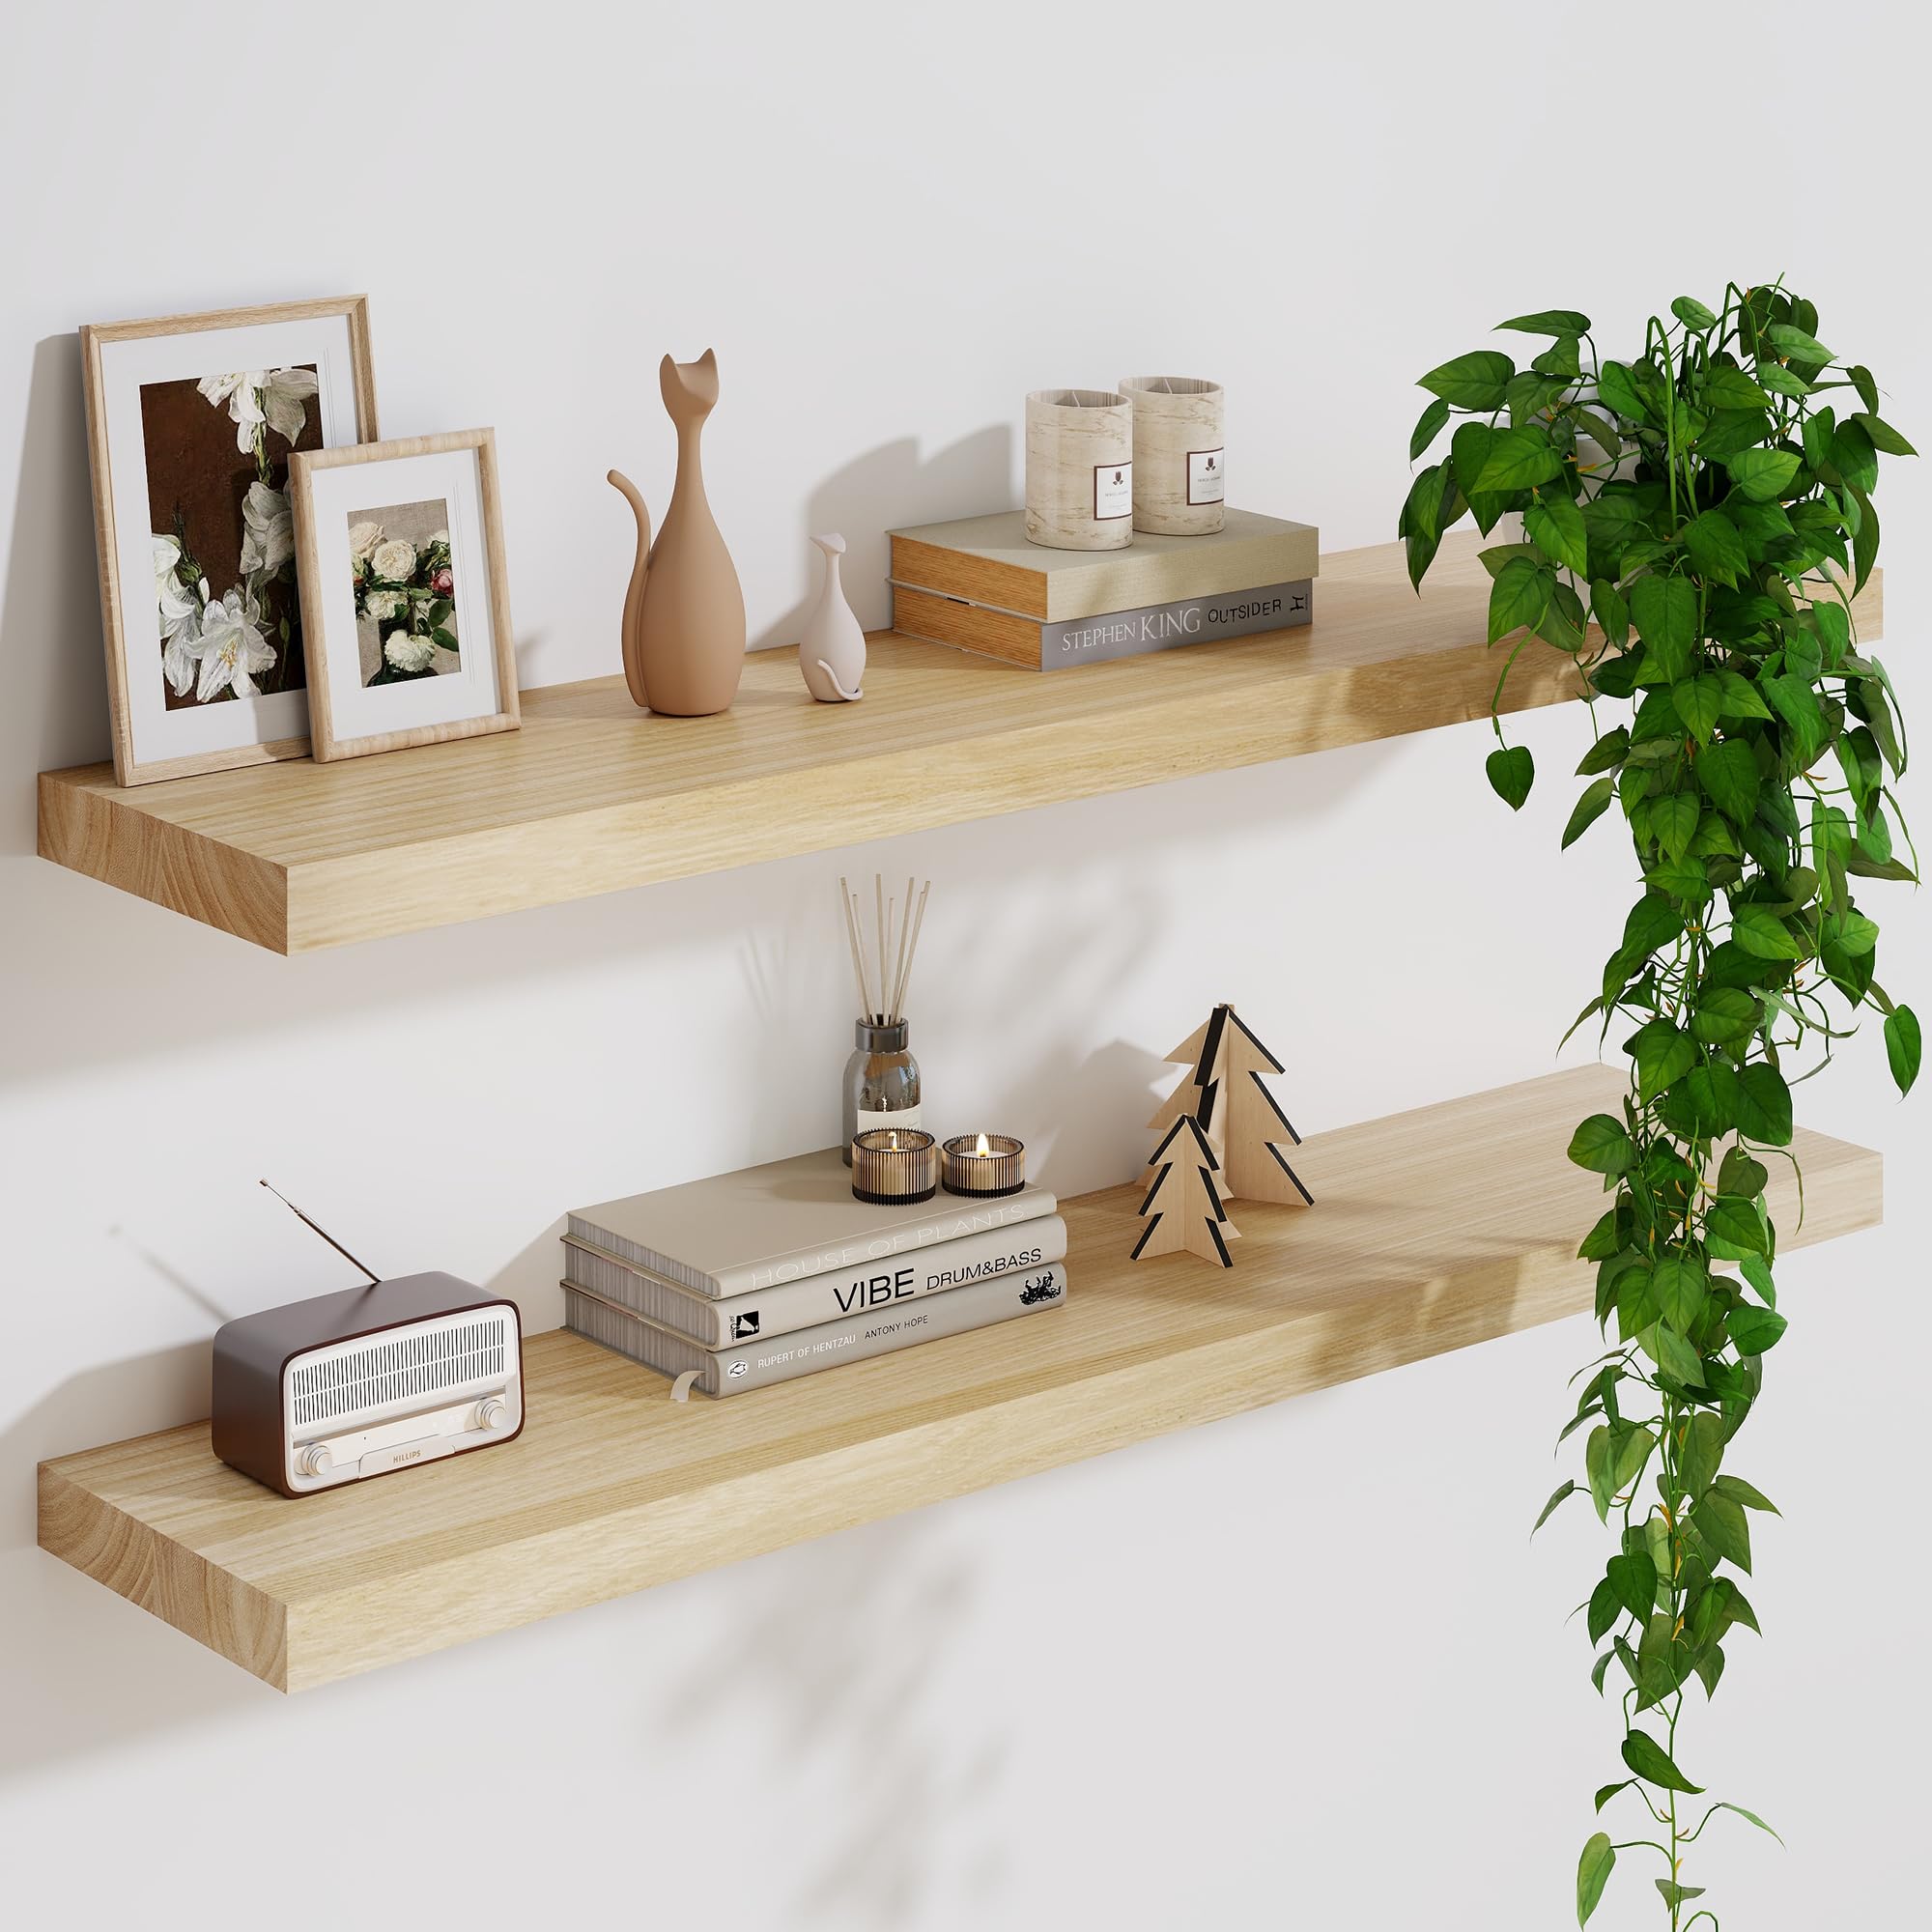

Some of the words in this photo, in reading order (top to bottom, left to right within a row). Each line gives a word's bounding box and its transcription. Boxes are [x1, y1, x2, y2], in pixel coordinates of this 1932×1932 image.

[1062, 621, 1136, 651] STEPHEN
[1140, 608, 1201, 641] KING
[1208, 598, 1282, 624] OUTSIDER
[751, 1248, 857, 1291] HOUSE
[868, 1235, 905, 1257] OF
[918, 1204, 1026, 1245] PLANTS
[833, 1267, 915, 1314] VIBE
[926, 1248, 1042, 1291] DRUM&BASS
[865, 1321, 901, 1340] ANTONY
[903, 1314, 929, 1329] HOPE
[757, 1350, 795, 1369] RUPERT
[797, 1348, 810, 1358] OF
[812, 1334, 857, 1354] HENTZAU
[393, 1450, 422, 1463] HILLIPS
